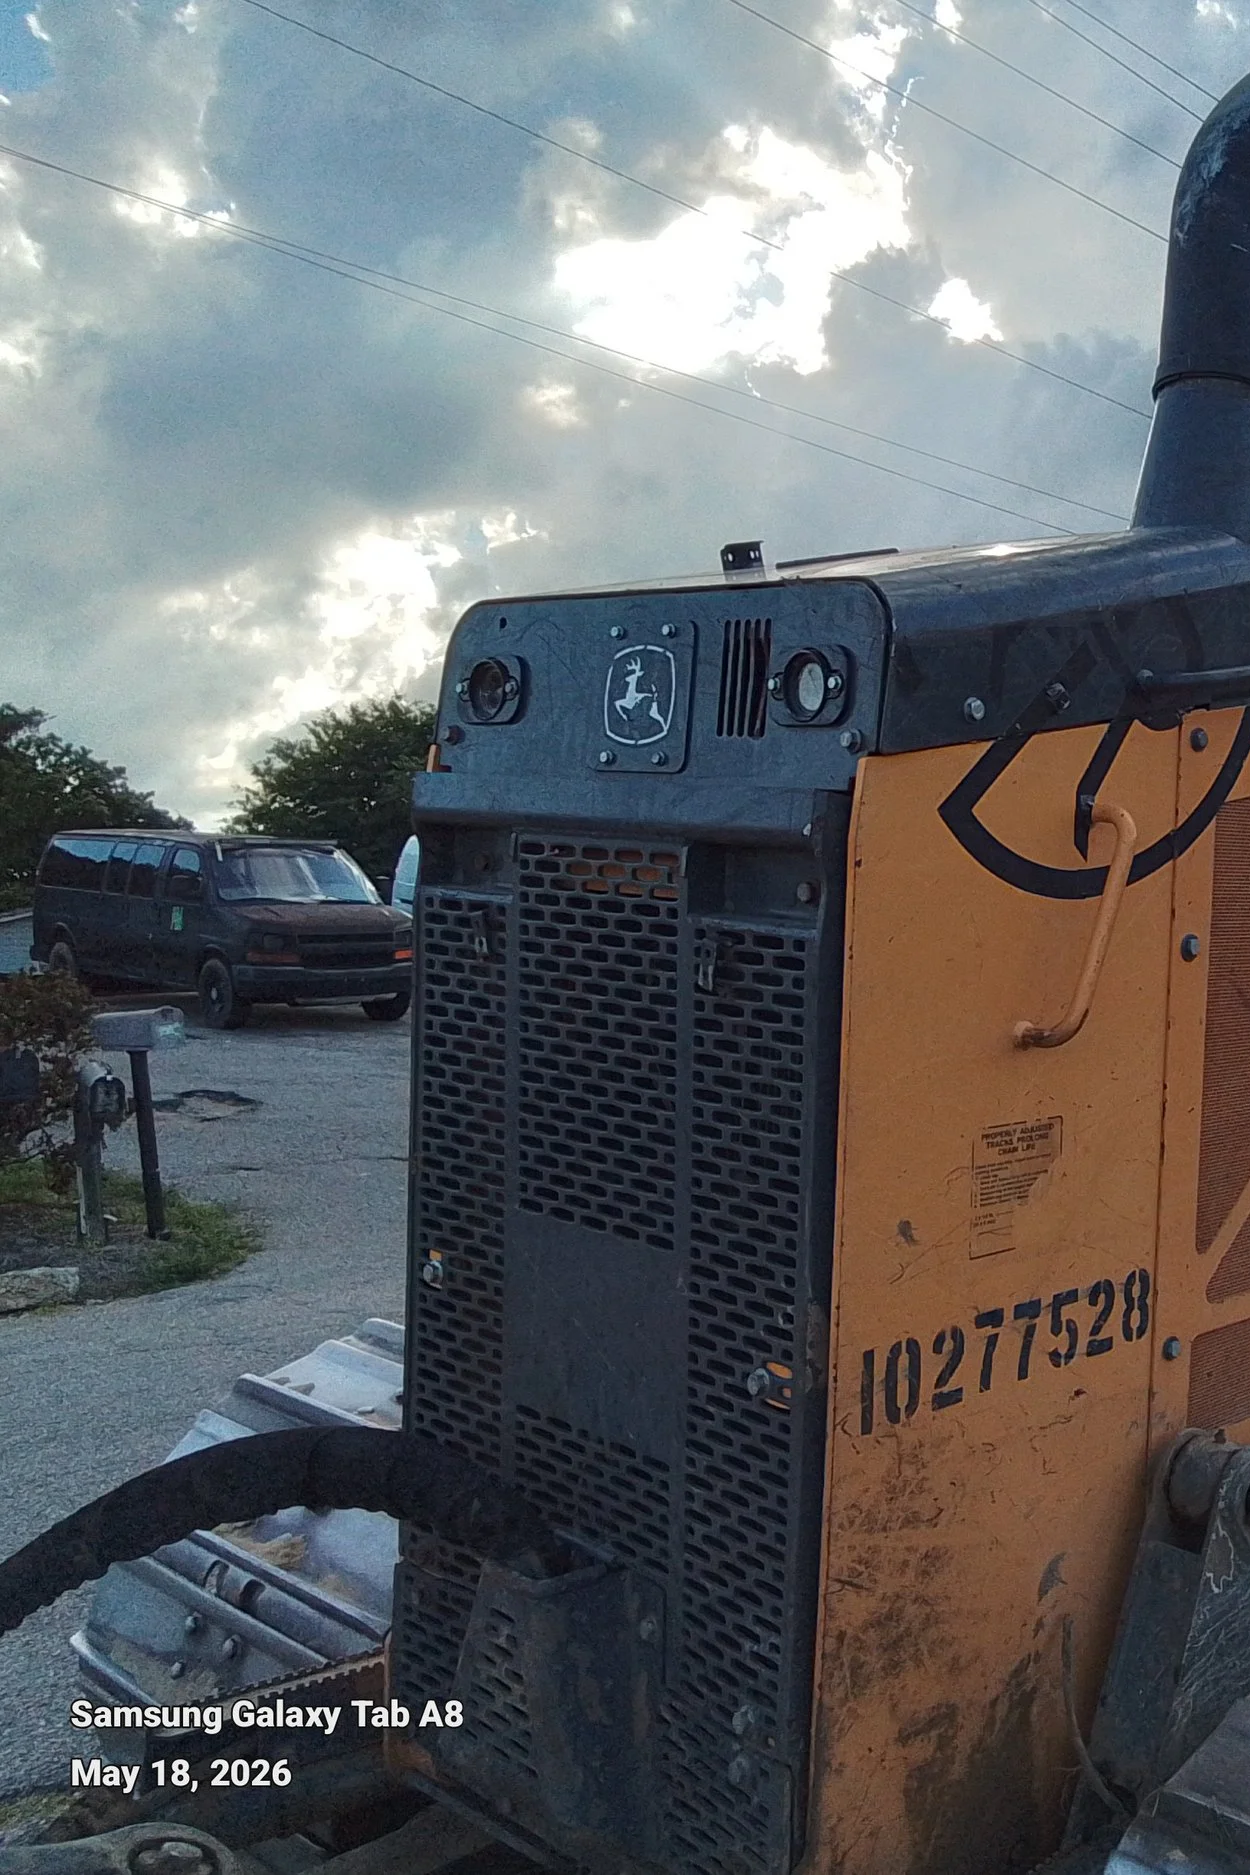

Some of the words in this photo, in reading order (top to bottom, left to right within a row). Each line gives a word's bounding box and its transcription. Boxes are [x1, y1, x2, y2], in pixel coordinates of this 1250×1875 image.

[981, 1129, 1017, 1141] PROPERLY
[1020, 1123, 1054, 1134] ADJUSTED
[986, 1139, 1014, 1149] TRACKS
[998, 1147, 1019, 1156] CHAIN
[1022, 1143, 1036, 1152] LIFE
[860, 1268, 1150, 1435] 10277528
